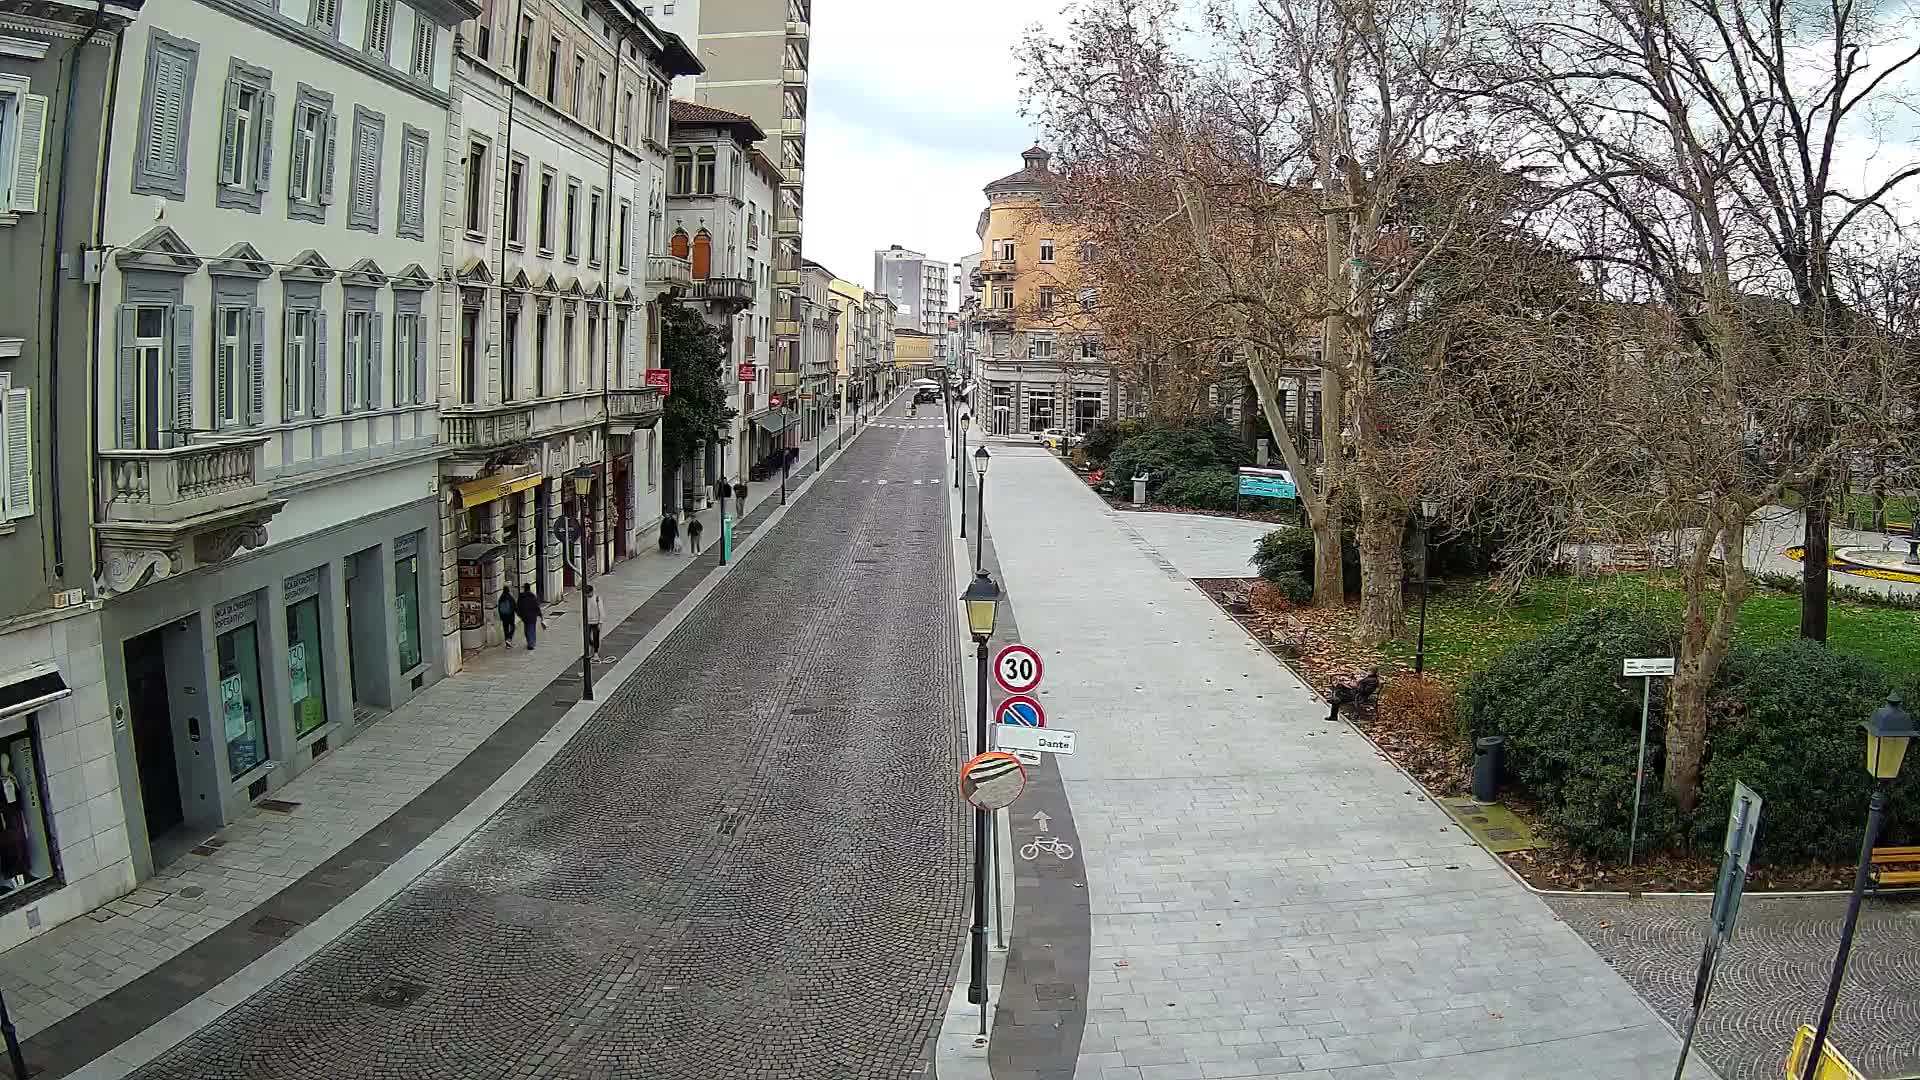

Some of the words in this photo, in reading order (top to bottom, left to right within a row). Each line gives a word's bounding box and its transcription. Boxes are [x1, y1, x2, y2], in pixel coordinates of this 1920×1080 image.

[1005, 658, 1033, 680] 30
[222, 677, 240, 701] 130
[1038, 738, 1069, 749] Dante
